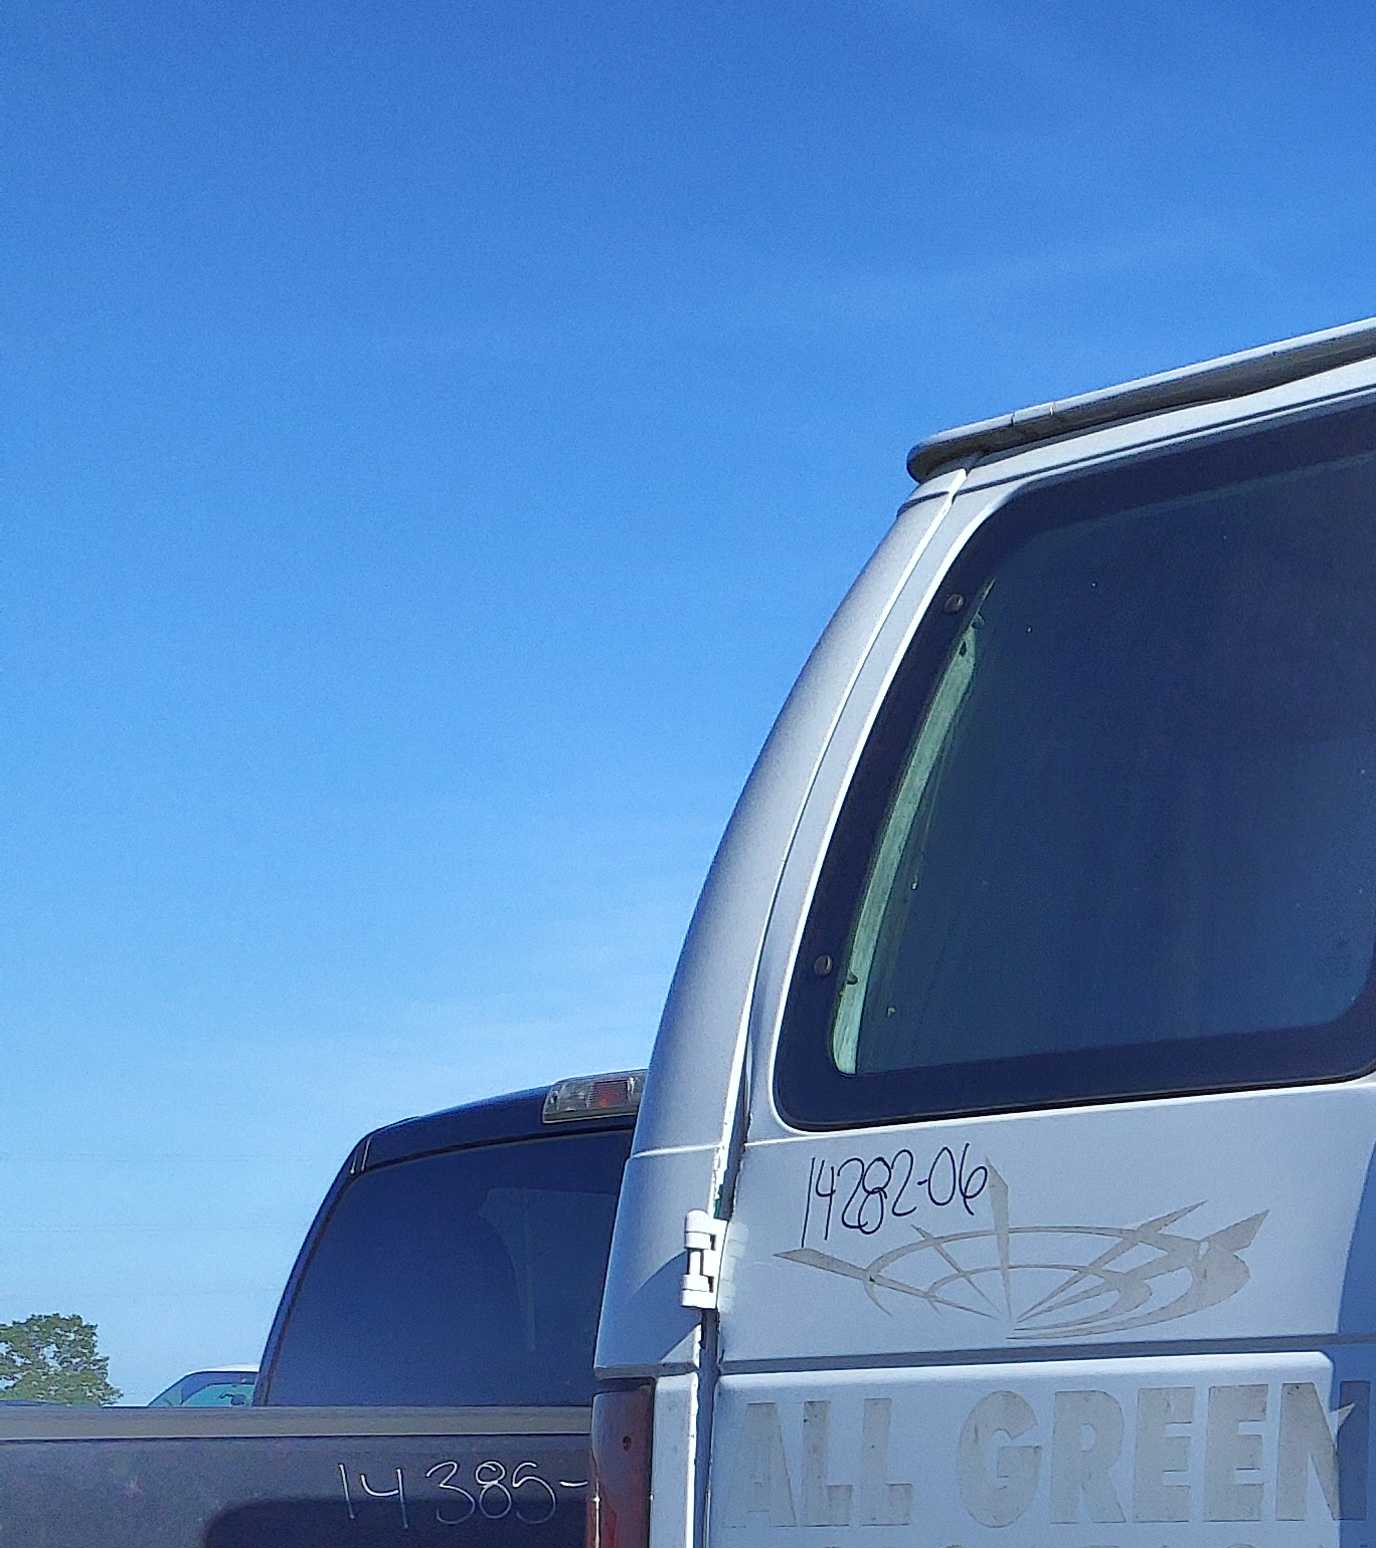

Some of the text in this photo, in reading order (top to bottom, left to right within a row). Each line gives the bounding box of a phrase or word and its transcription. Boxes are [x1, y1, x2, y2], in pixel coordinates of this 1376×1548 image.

[800, 1142, 989, 1248] 14282-06
[722, 1379, 1372, 1530] ALL GREEN
